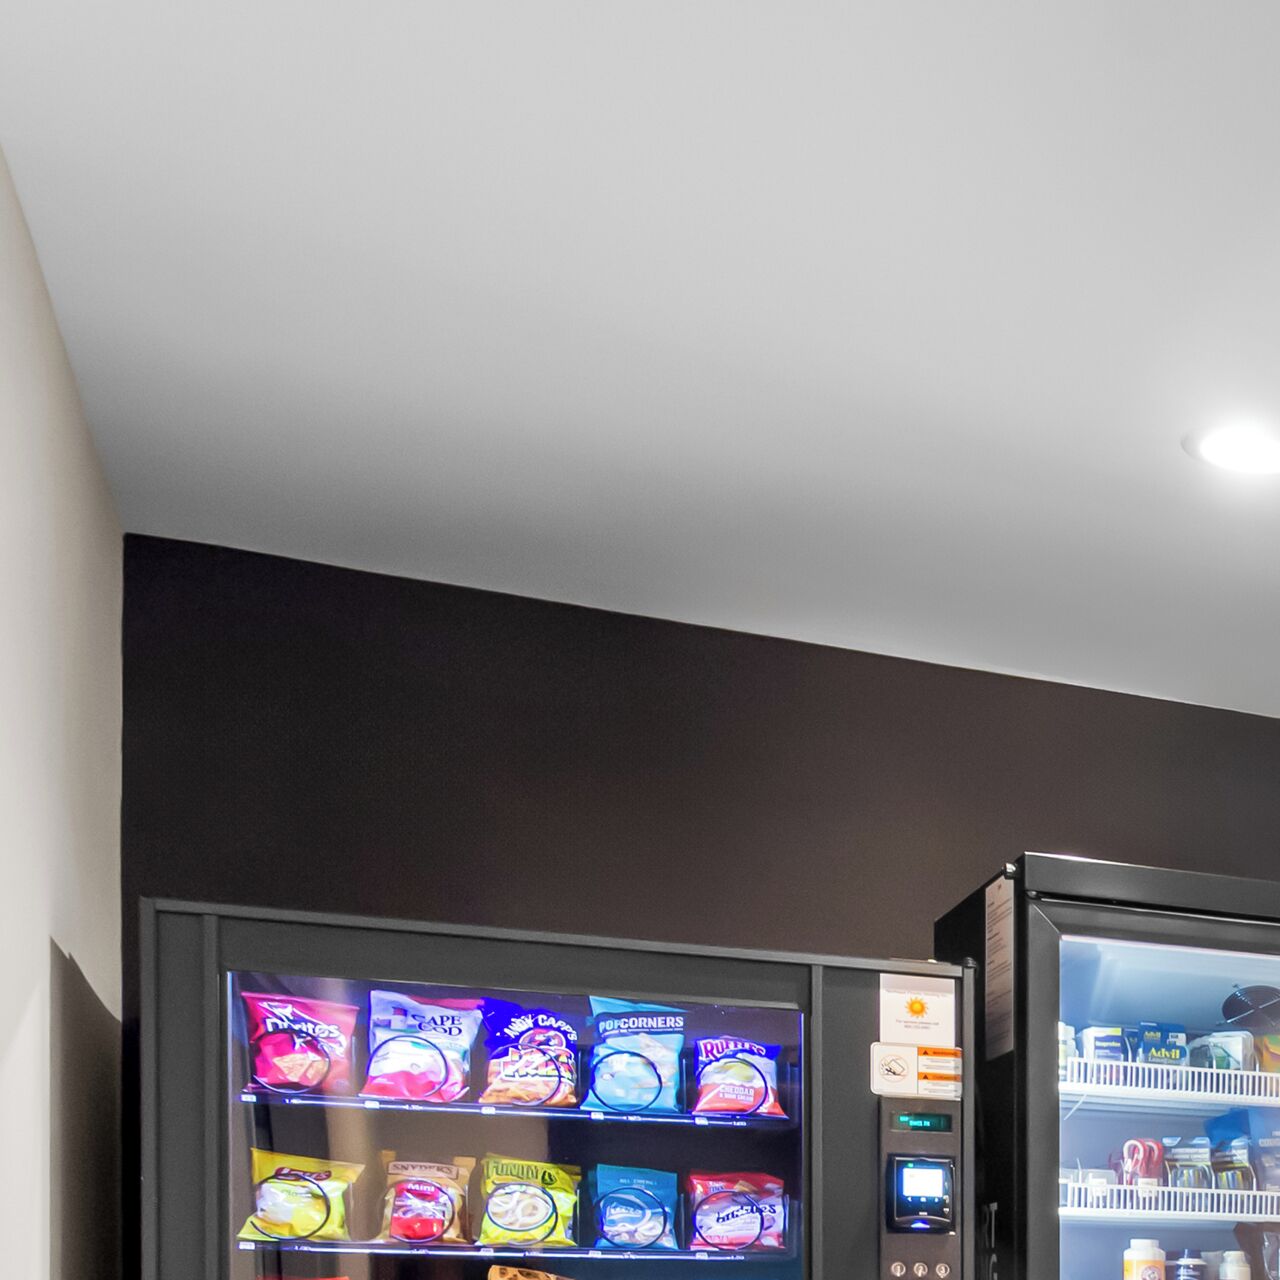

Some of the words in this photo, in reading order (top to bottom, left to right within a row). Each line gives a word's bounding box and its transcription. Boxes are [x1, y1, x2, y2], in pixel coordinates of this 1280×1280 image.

[411, 1014, 463, 1027] CAPE
[599, 1016, 684, 1033] POPCORNERS
[417, 1022, 463, 1036] COD
[1150, 1047, 1180, 1059] Advil
[407, 1183, 435, 1192] Mini
